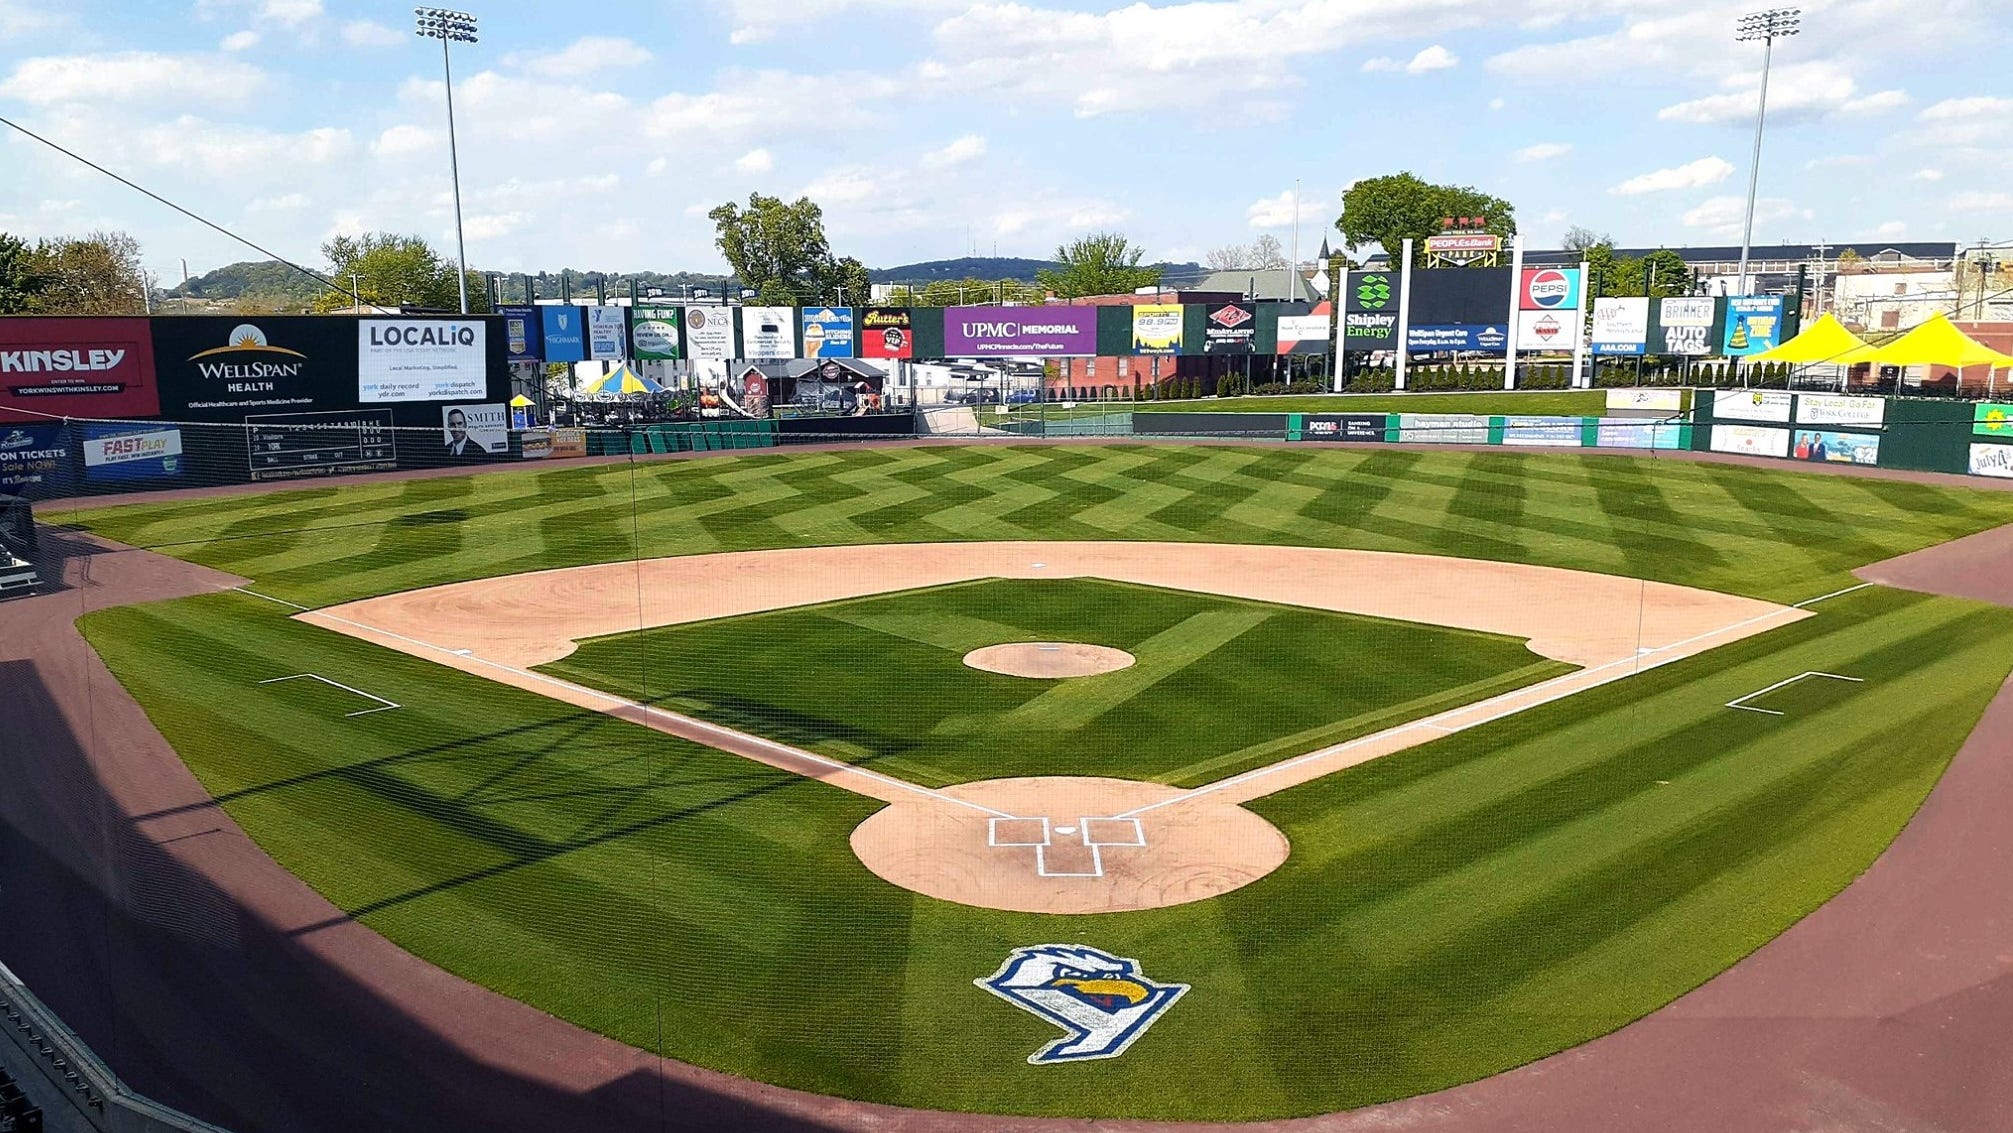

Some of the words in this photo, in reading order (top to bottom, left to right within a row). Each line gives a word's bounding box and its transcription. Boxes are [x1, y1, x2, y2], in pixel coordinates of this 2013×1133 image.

[1532, 284, 1568, 293] PEPSI
[633, 309, 656, 319] HAVING
[657, 309, 674, 319] FUN?
[1665, 305, 1710, 318] BRIMMER
[1138, 318, 1164, 326] 98.9
[1346, 314, 1396, 328] Shipley
[370, 326, 475, 346] LOCALiQ
[962, 323, 1017, 338] UPMC
[1022, 325, 1079, 334] MEMORIAL
[1346, 326, 1392, 338] Energy
[1665, 326, 1707, 340] AUTO
[1600, 343, 1637, 352] AAA.COM
[1665, 339, 1704, 352] TAGS
[0, 349, 125, 373] KINSLEY
[18, 385, 119, 395] YORKWINSWITHKINSLEY.COM
[227, 382, 274, 393] HEALTH
[363, 384, 379, 392] york
[380, 383, 397, 391] daily
[428, 388, 483, 397] yorkdispatch.com
[1804, 397, 1822, 407] Stay
[467, 412, 505, 422] SMITH
[0, 452, 17, 461] ON
[19, 449, 66, 460] TICKETS
[2, 461, 24, 472] Sale
